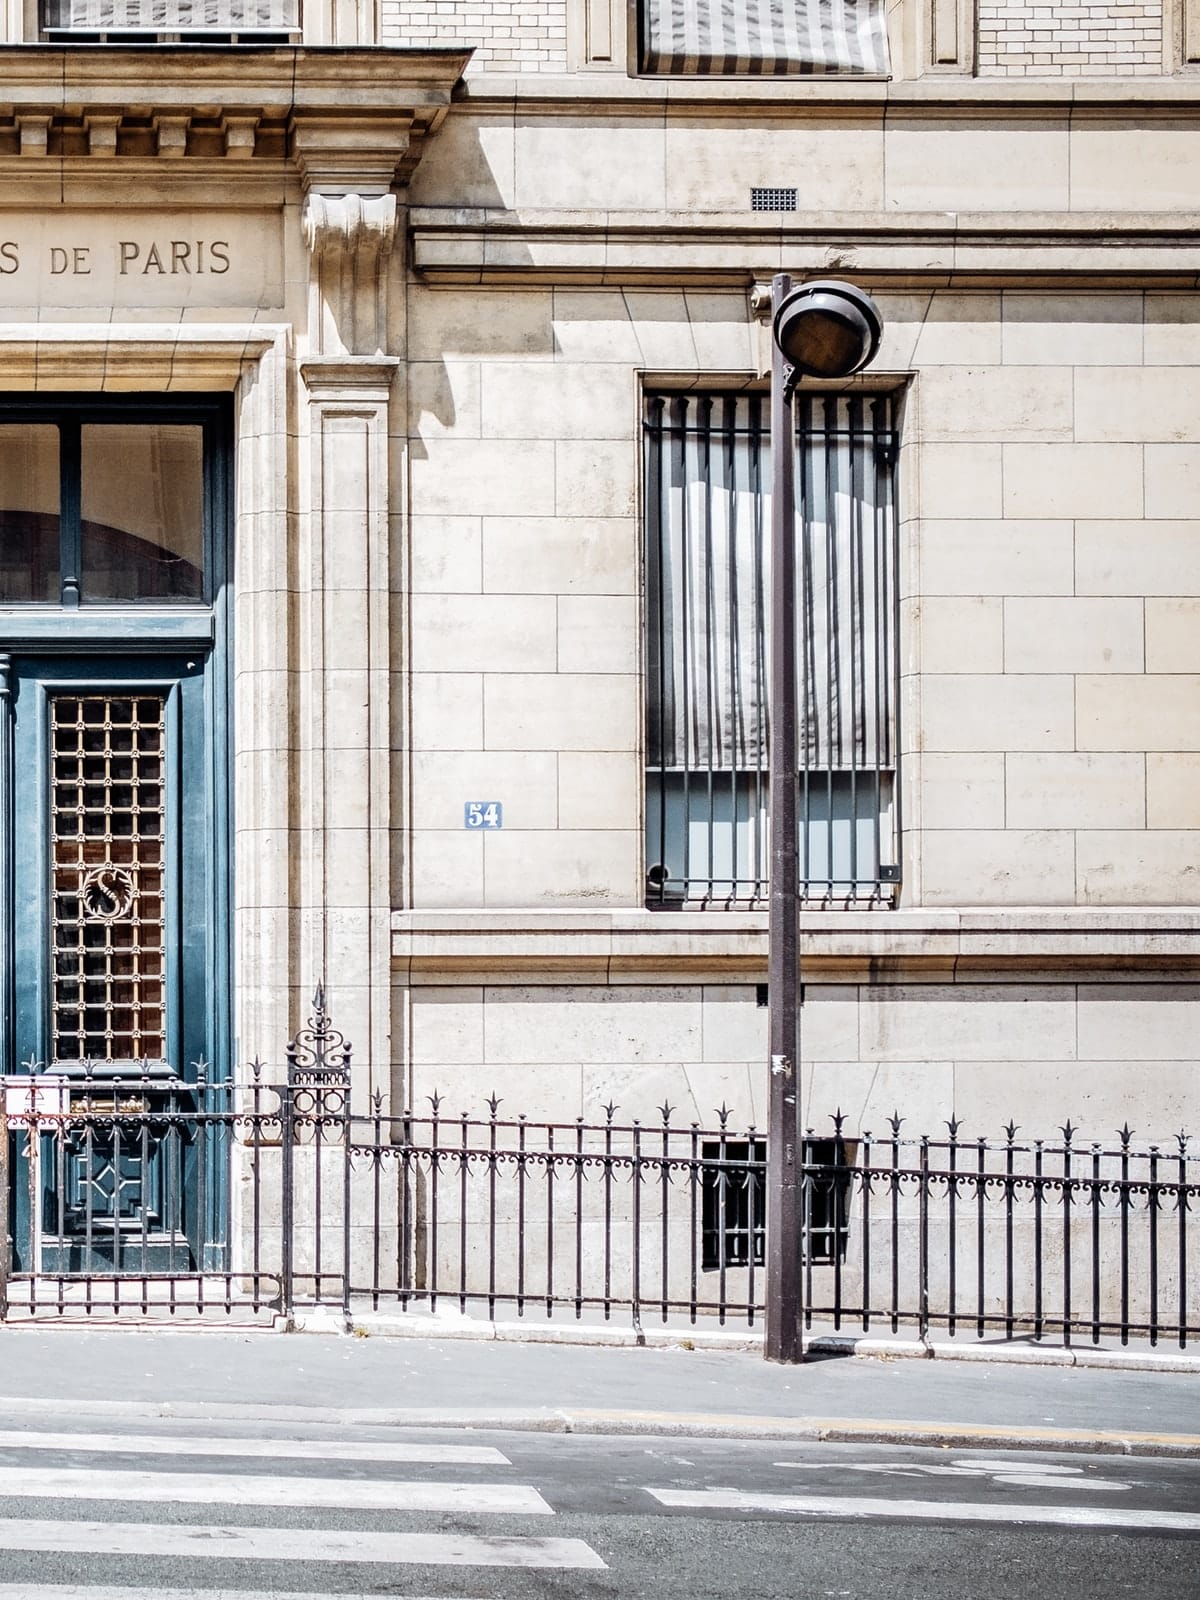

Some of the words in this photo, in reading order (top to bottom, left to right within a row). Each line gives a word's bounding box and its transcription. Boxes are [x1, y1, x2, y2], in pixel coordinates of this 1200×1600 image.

[50, 247, 91, 275] DE
[119, 240, 230, 275] PARIS
[468, 803, 498, 827] 54
